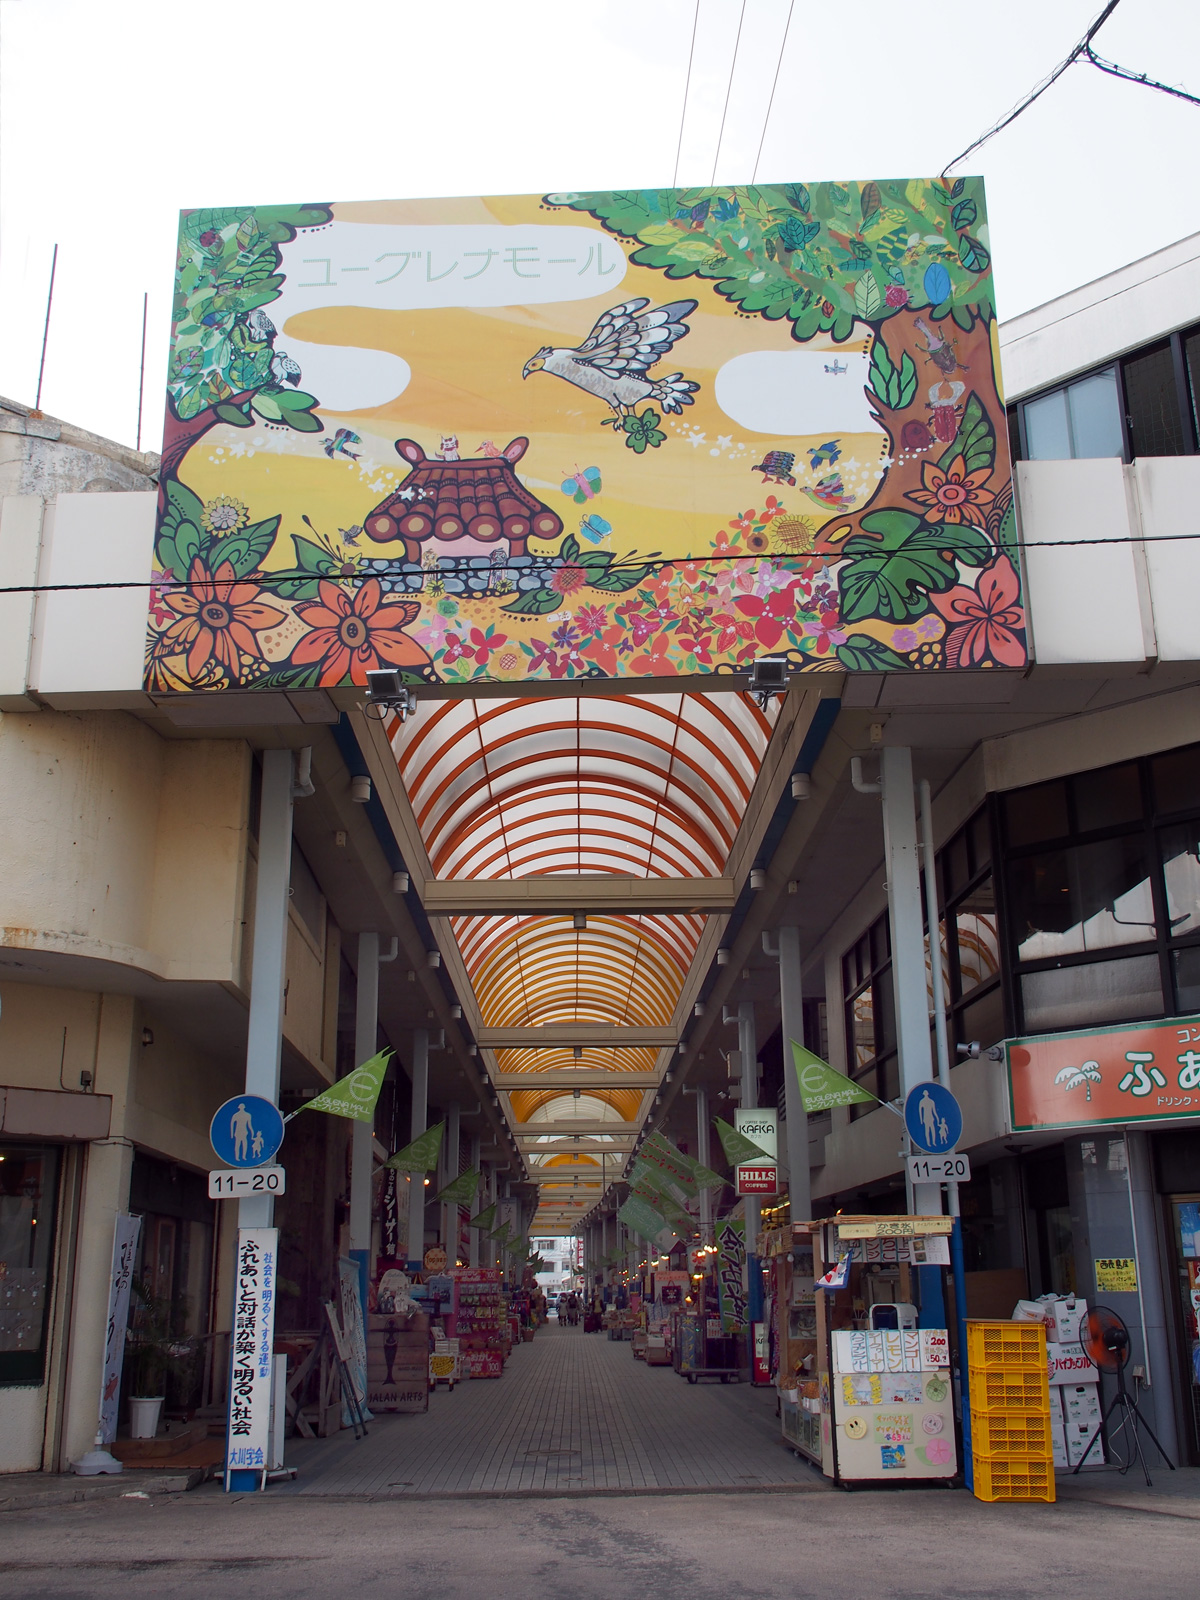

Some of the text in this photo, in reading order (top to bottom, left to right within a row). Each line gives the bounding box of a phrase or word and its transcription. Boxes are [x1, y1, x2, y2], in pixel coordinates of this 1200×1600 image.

[298, 243, 616, 287] ユーグレナモール
[805, 1088, 862, 1104] EUGLENA MALL
[350, 1103, 371, 1115] MALL
[739, 1125, 775, 1134] KAFKA
[739, 1171, 776, 1181] HILLS
[913, 1160, 967, 1177] 11-20
[215, 1174, 279, 1192] 11-20
[231, 1239, 260, 1436] ふれあいと対話が築く明るい社会
[886, 1332, 902, 1369] レモン
[903, 1331, 919, 1369] マンゴー
[1055, 1357, 1092, 1370] パイナップル
[369, 1391, 424, 1402] JALAN ARTS
